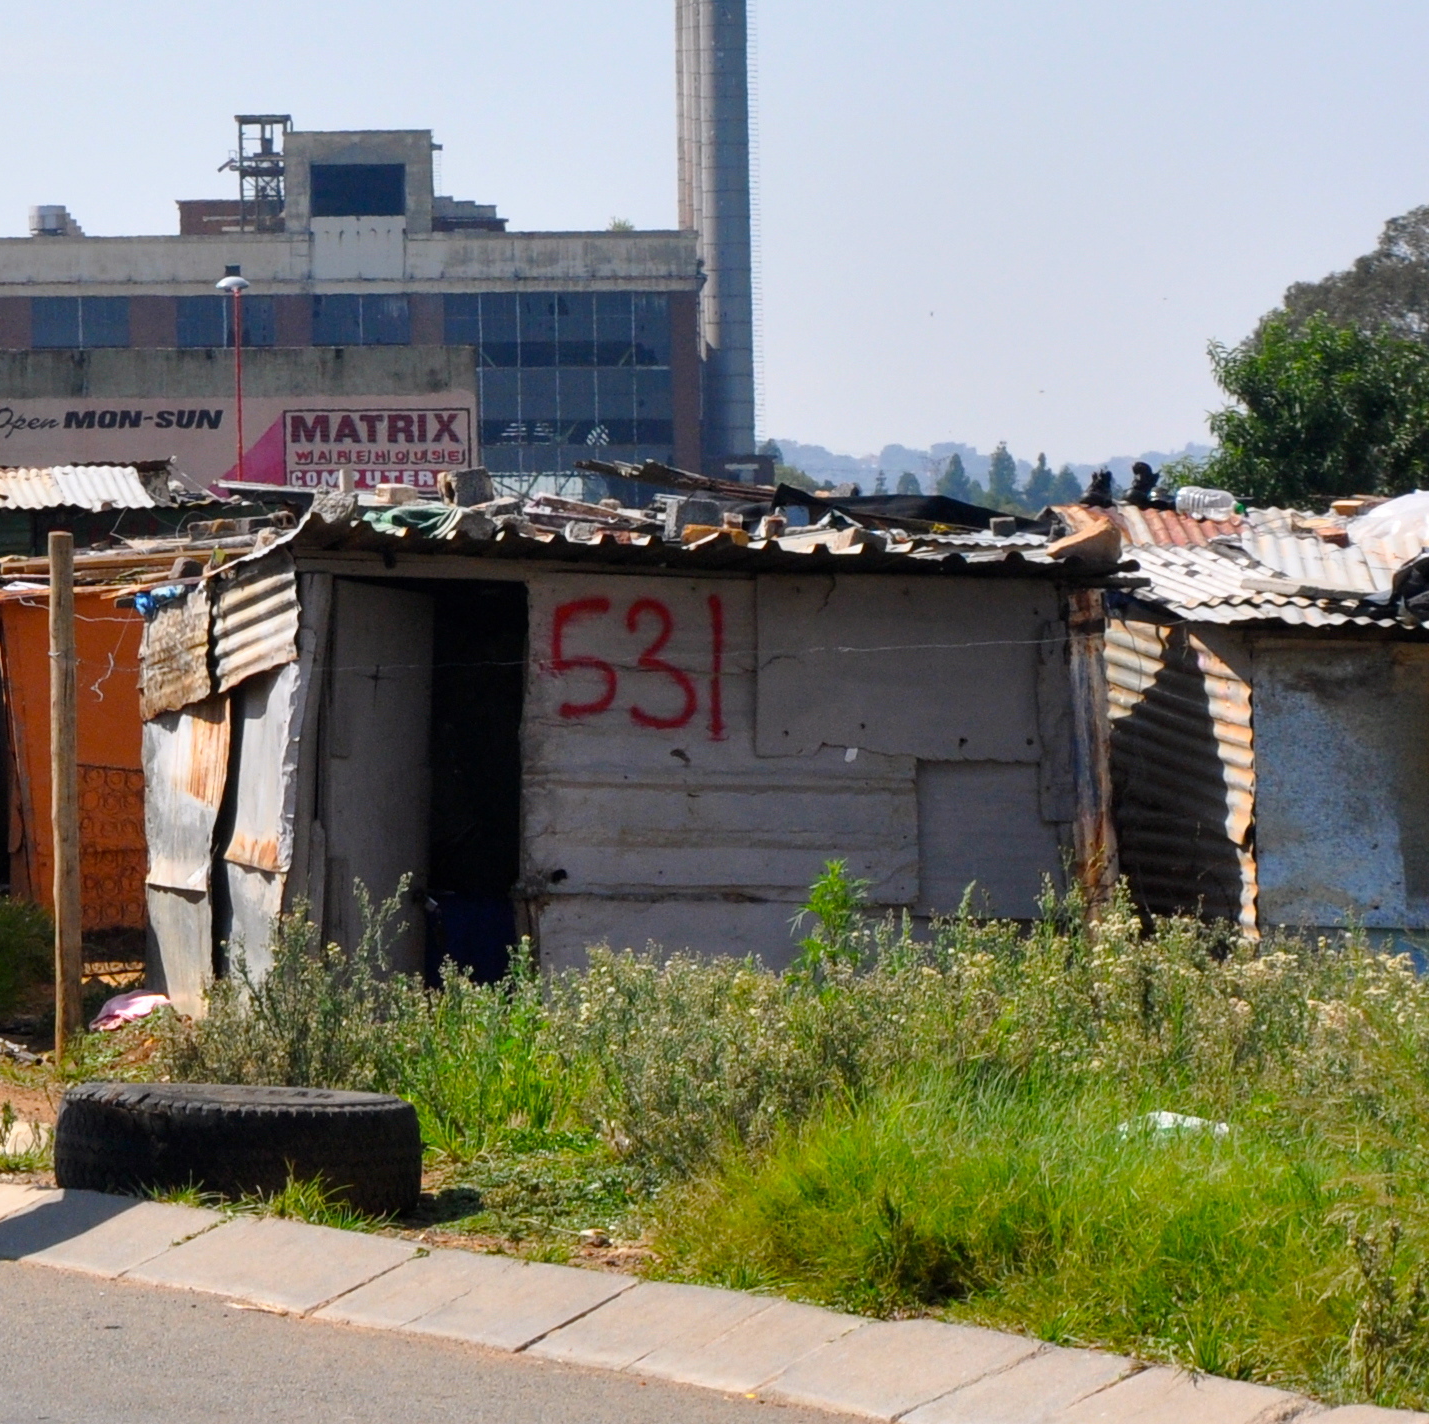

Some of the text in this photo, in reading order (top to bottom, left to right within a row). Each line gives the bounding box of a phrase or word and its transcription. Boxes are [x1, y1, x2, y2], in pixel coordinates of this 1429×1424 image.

[63, 409, 224, 430] MON-SUN
[291, 413, 462, 444] MATRIX
[295, 450, 463, 463] WAREHOUSE
[550, 594, 725, 740] 531
